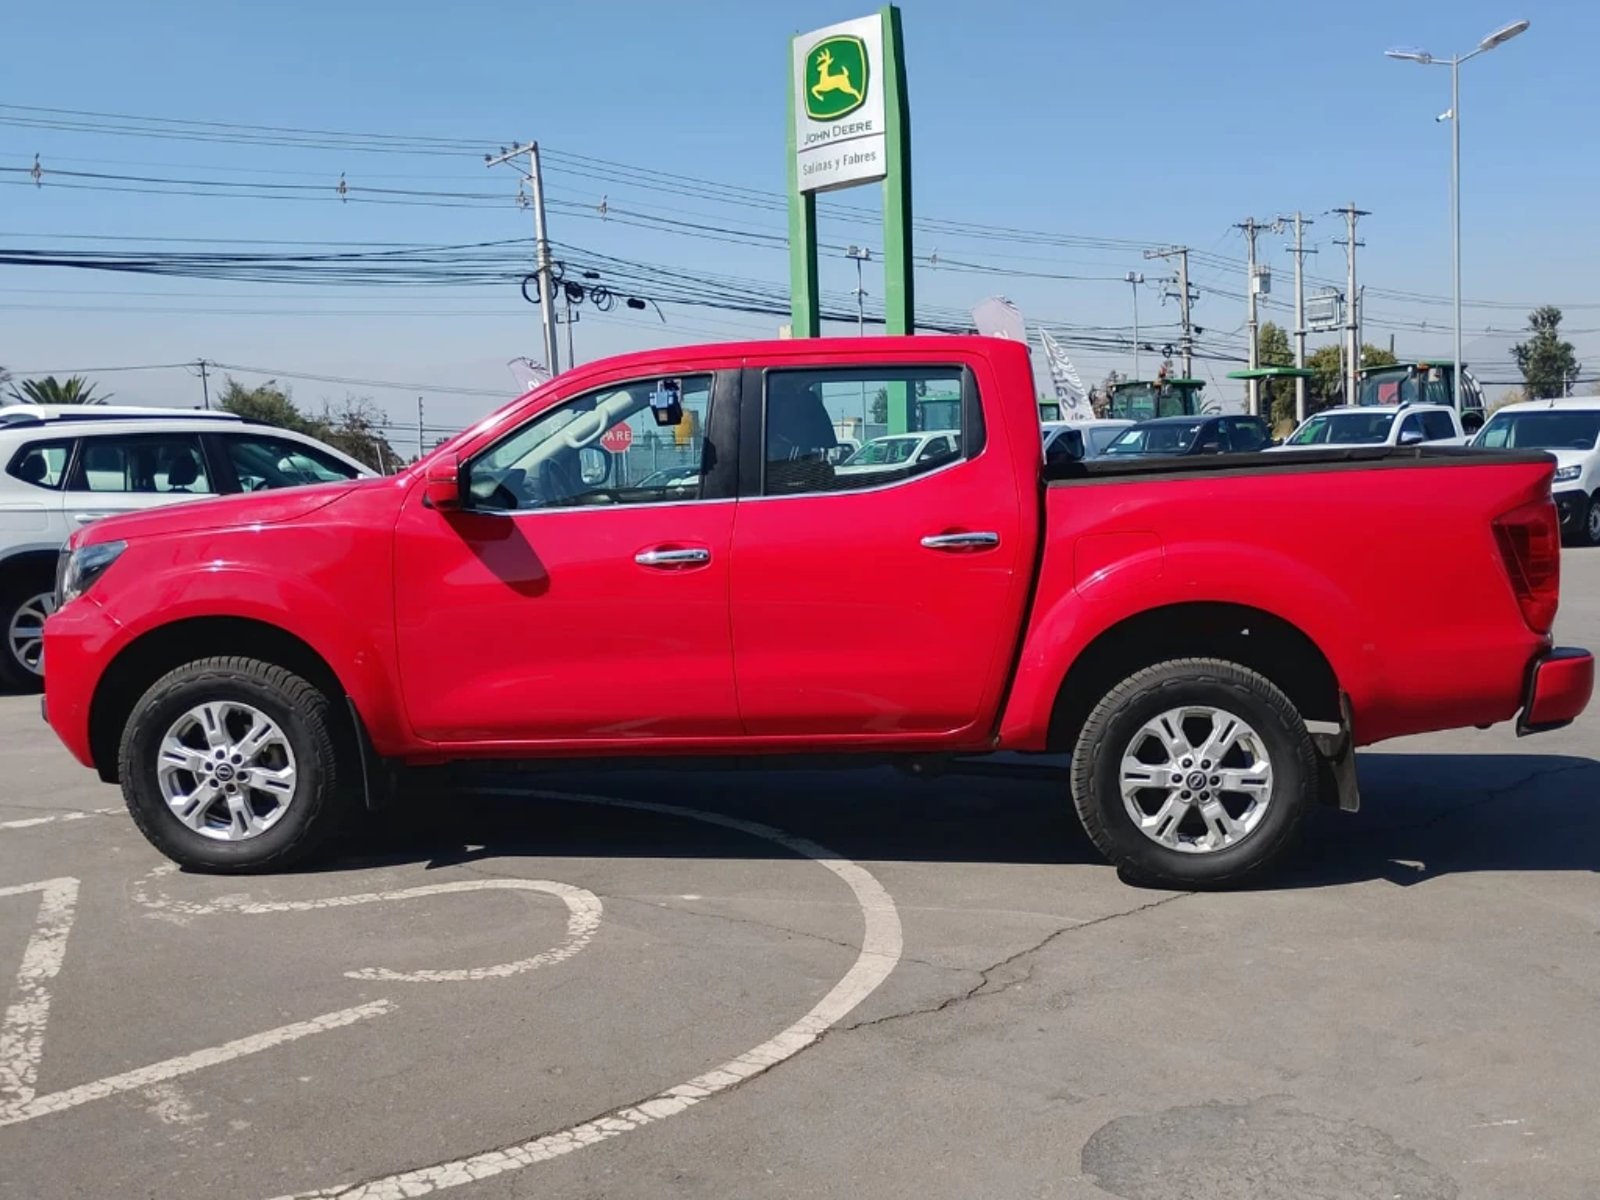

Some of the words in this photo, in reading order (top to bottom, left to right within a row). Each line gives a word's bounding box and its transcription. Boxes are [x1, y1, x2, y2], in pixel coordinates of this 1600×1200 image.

[804, 129, 831, 145] JOHN
[832, 120, 873, 137] DEERE
[802, 160, 832, 176] Salinas
[835, 158, 840, 171] y
[843, 151, 876, 166] Fabres
